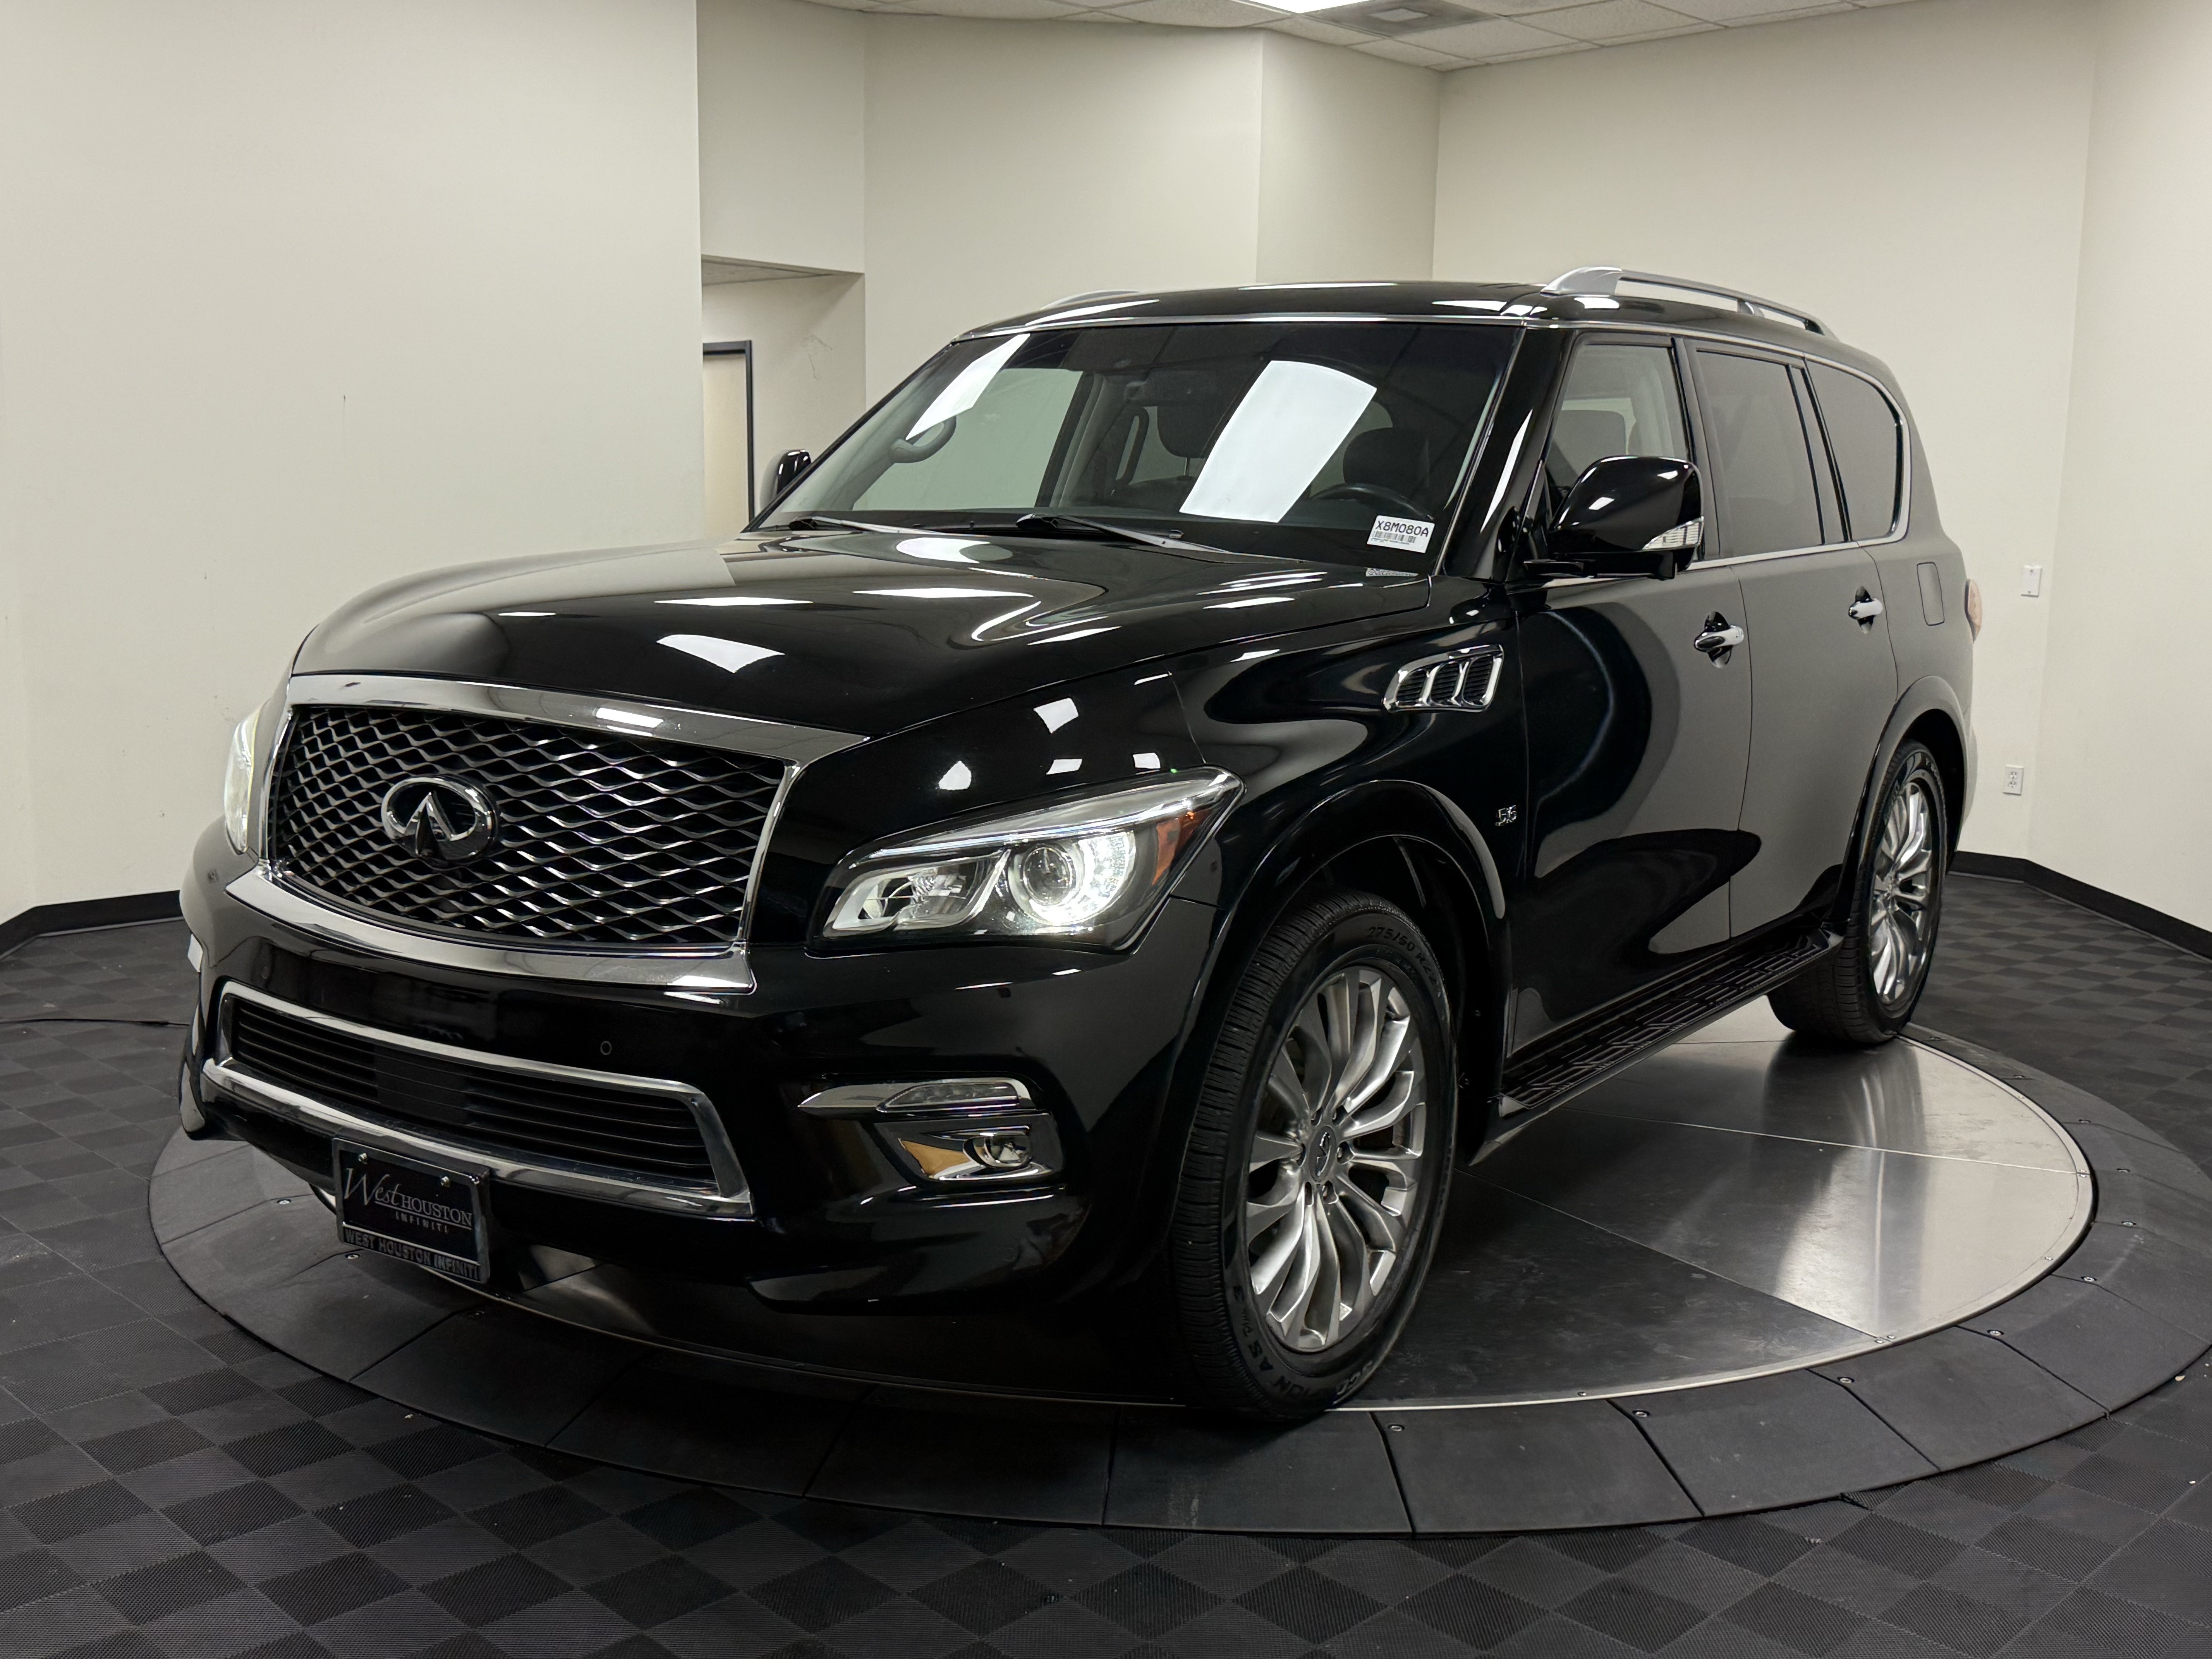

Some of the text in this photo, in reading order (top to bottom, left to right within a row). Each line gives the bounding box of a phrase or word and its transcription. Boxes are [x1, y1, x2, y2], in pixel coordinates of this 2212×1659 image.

[1375, 520, 1429, 537] X8M080A
[343, 1168, 472, 1226] West HOUSTON
[395, 1211, 448, 1233] INFINITI
[345, 1229, 376, 1248] WEST
[378, 1238, 431, 1265] HOUSTON
